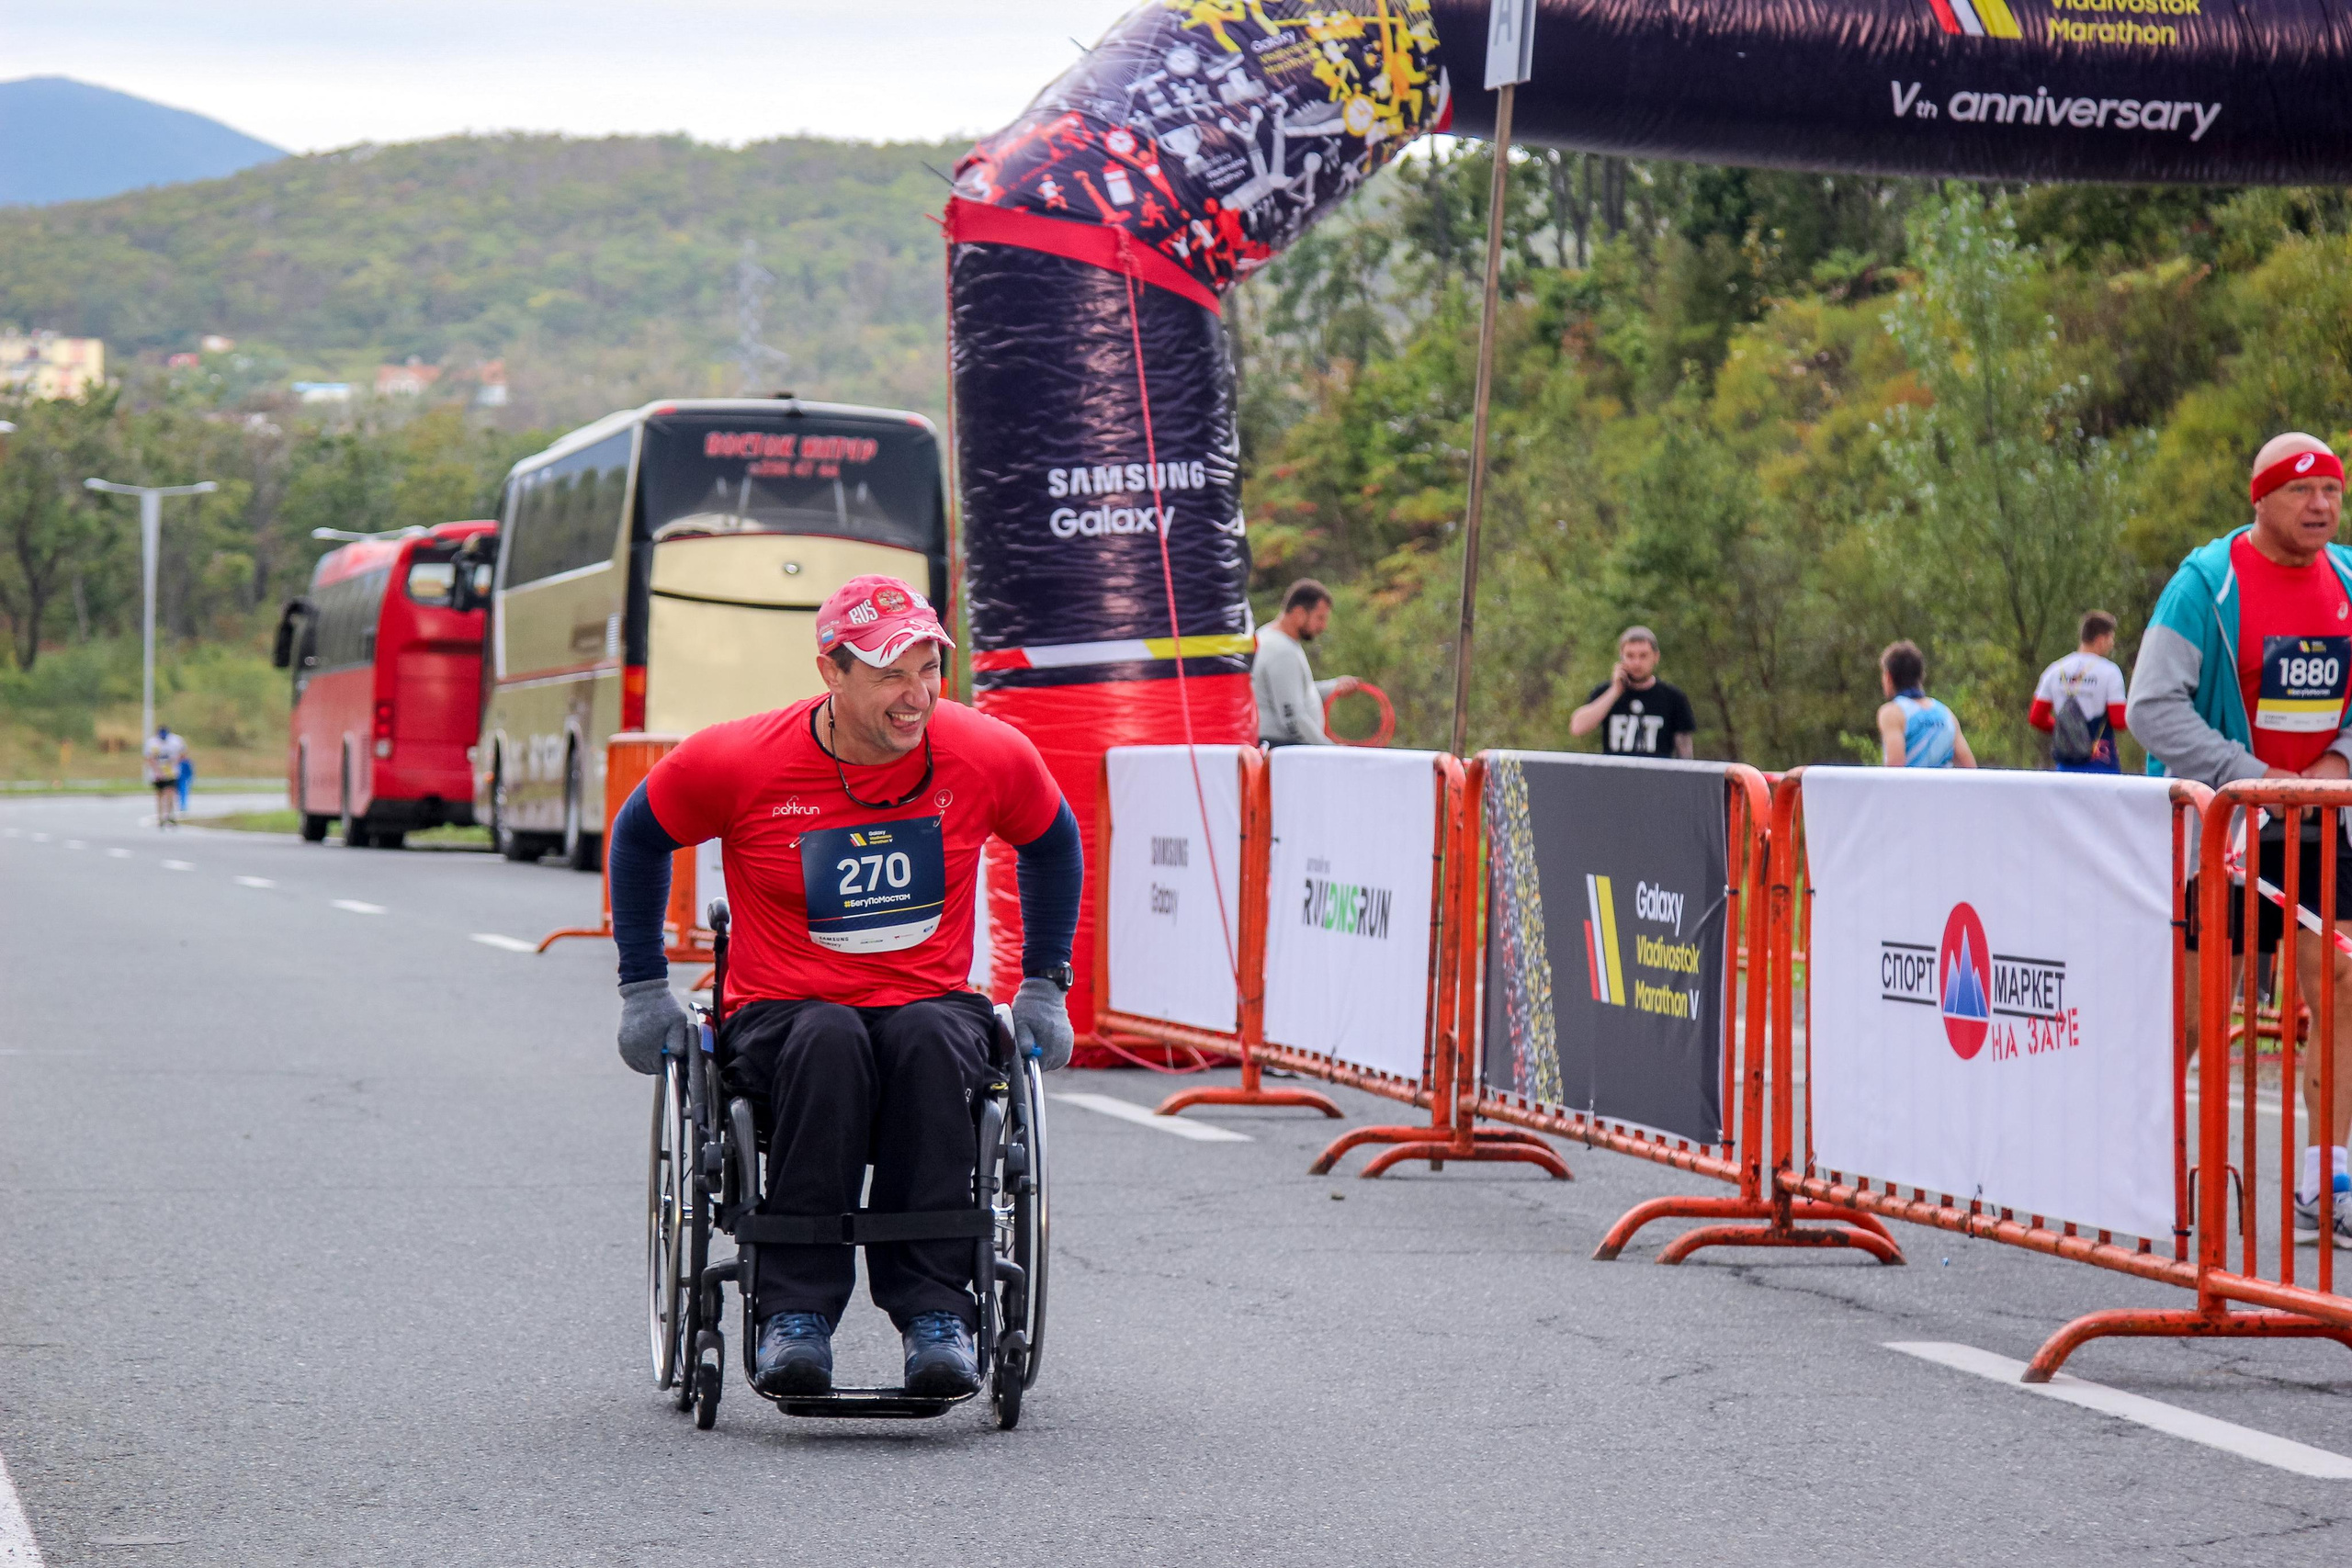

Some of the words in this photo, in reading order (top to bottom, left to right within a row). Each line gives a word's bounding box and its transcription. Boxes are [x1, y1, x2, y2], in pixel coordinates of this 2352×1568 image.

[2049, 17, 2177, 46] Marathon
[1948, 86, 2222, 142] anniversary
[1047, 460, 1206, 499] SAMSUNG
[1049, 504, 1176, 540] Galaxy
[848, 599, 879, 625] RUS
[2278, 657, 2339, 687] 1880
[772, 797, 820, 818] parkrun
[836, 852, 911, 896] 270
[1635, 880, 1684, 938] Galaxy
[1635, 933, 1700, 975] Vladivostok
[1634, 978, 1688, 1019] Marathon
[1689, 988, 1700, 1021] V
[1882, 952, 1935, 994] СПОРТ
[1995, 964, 2065, 1011] МАРКЕТ
[1992, 1022, 2018, 1062] НА
[2028, 1007, 2079, 1055] ЗАРЕ
